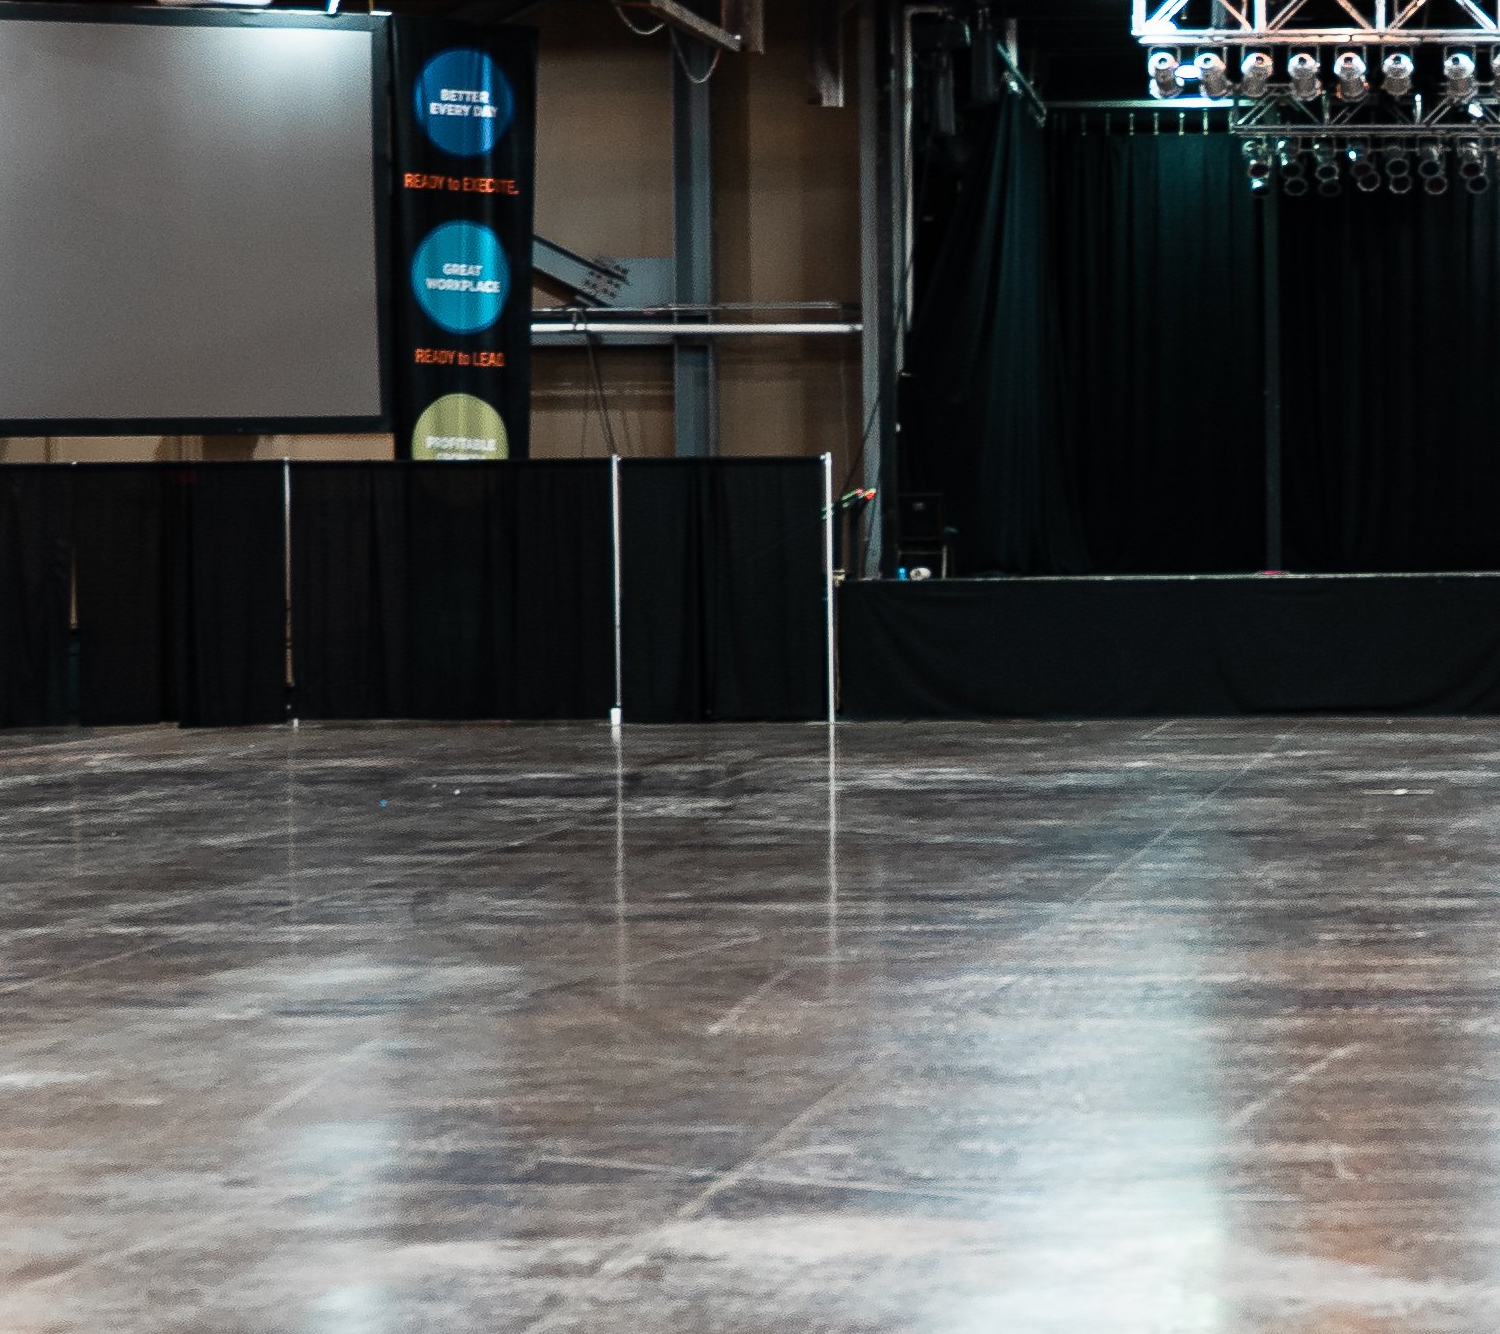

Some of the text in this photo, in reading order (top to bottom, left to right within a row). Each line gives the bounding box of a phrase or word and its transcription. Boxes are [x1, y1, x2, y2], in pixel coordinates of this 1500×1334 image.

[440, 88, 489, 104] BETTER
[429, 102, 472, 116] EVERY
[404, 173, 445, 190] READY
[447, 176, 460, 191] to
[443, 263, 483, 276] GREAT
[425, 278, 500, 293] WORKPLACE
[415, 348, 455, 365] READY
